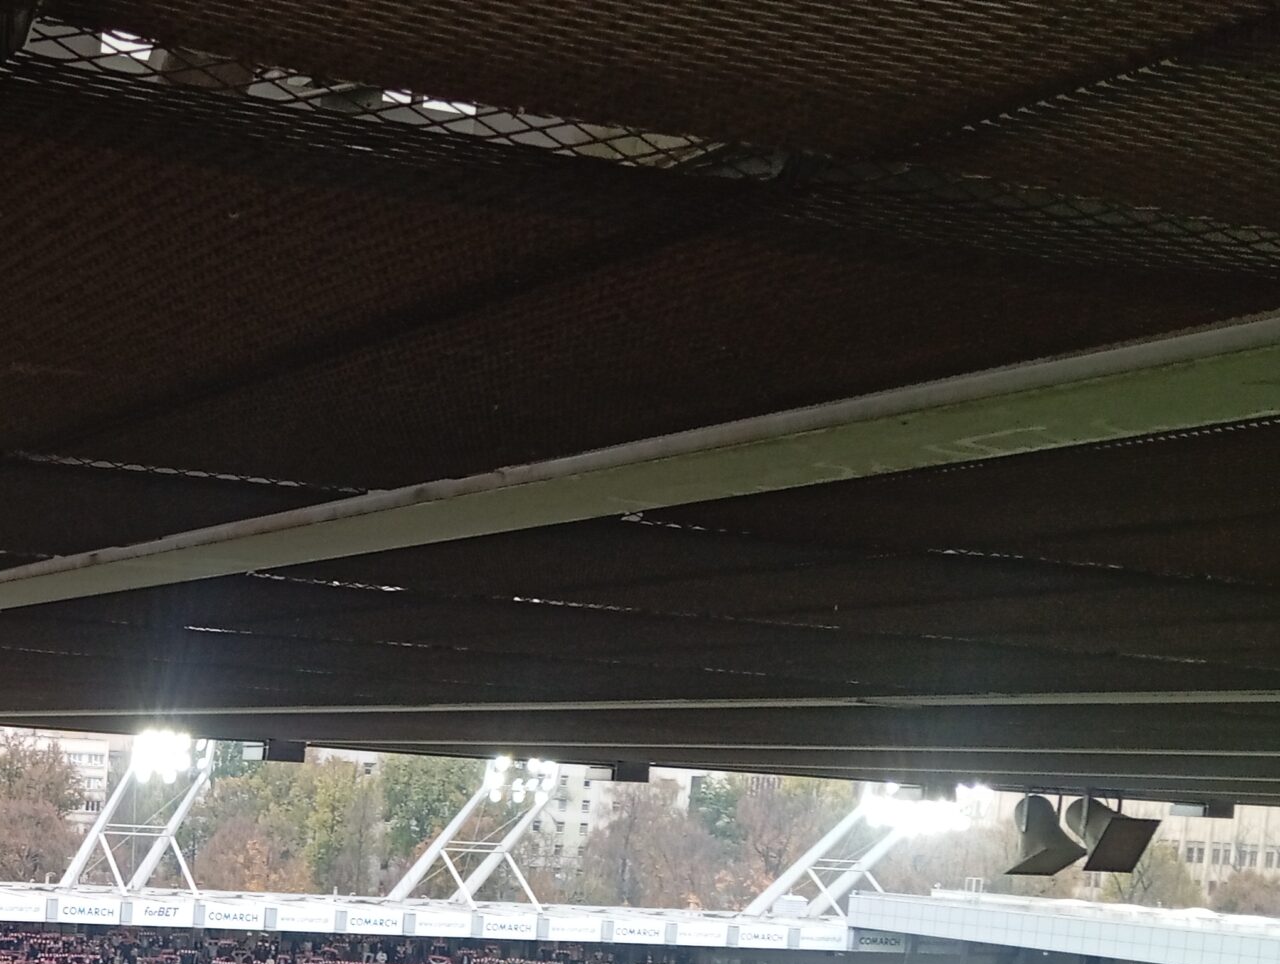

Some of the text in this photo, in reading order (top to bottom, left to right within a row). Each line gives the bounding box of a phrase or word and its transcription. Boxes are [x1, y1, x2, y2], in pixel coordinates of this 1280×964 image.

[62, 906, 114, 917] COMARCH
[144, 907, 180, 918] forBET
[208, 911, 258, 922] COMARCH
[349, 917, 398, 928] COMARCH
[486, 922, 532, 932] COMARCH
[615, 926, 660, 938] COMARCH
[740, 932, 783, 942] COMARCH
[859, 936, 901, 947] COMARCH
